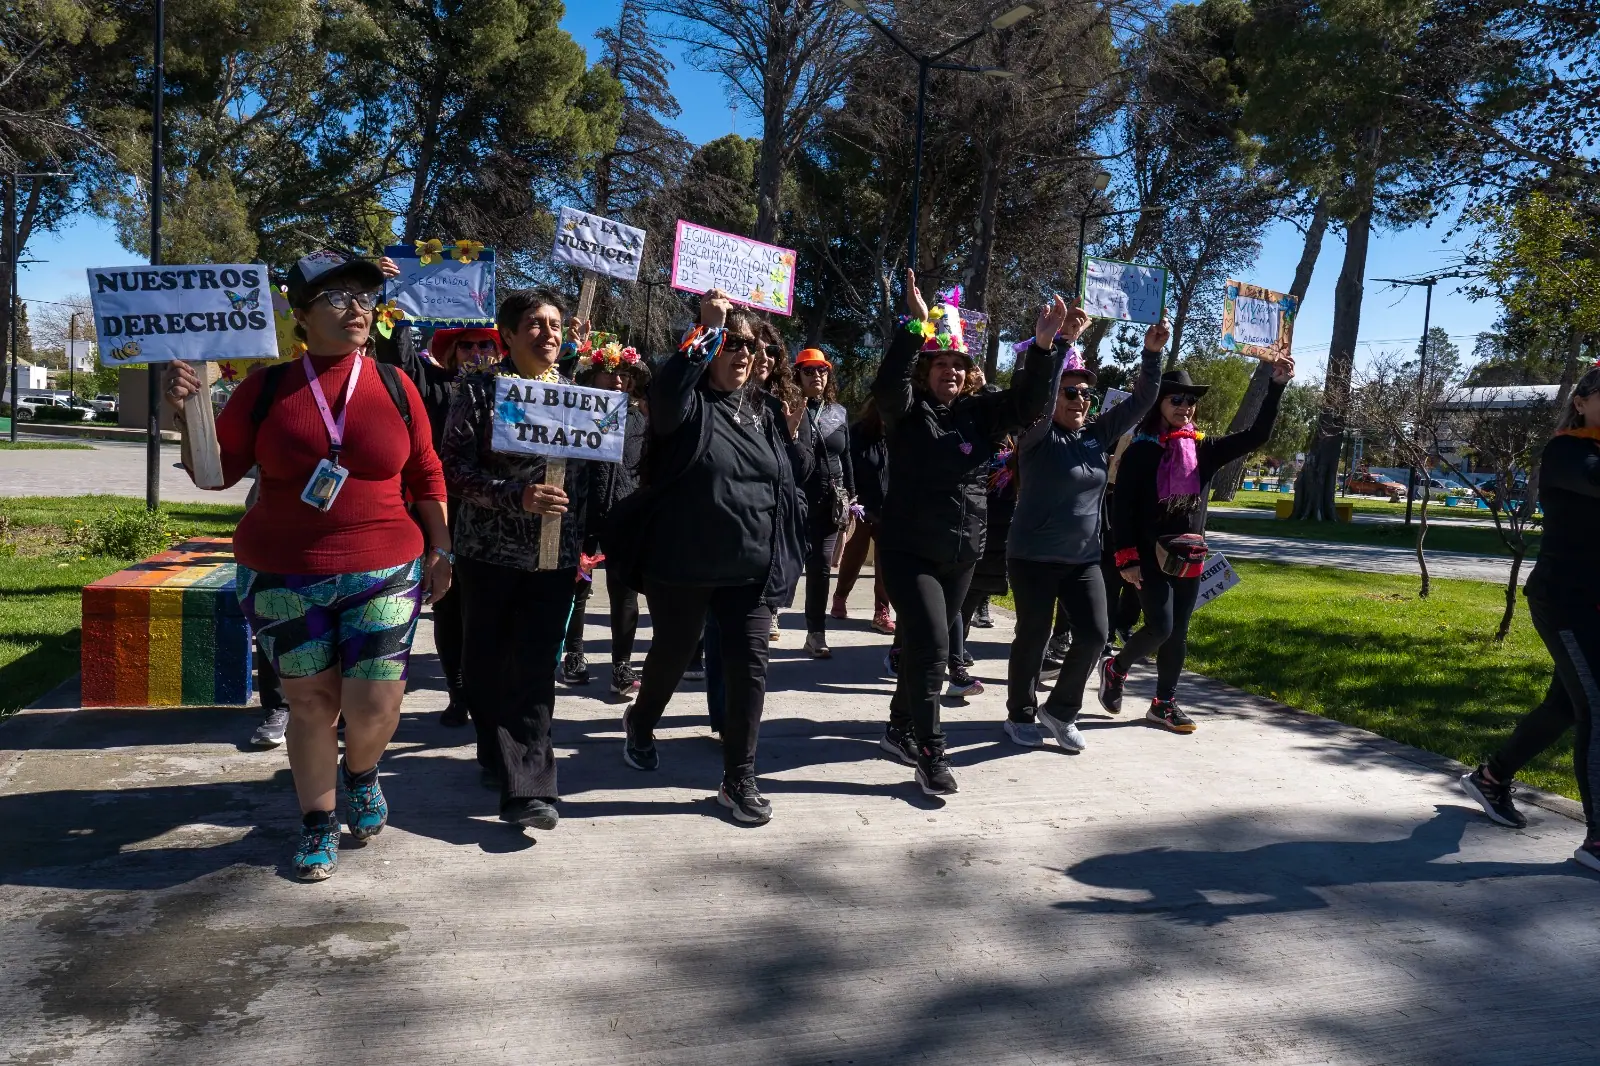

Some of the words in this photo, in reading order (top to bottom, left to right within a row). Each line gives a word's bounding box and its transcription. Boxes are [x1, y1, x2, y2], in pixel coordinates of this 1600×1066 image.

[579, 215, 590, 227] A
[601, 220, 621, 236] LA
[558, 234, 634, 265] JUSTICIA
[679, 240, 770, 275] DISCRIMINACION
[684, 227, 739, 252] IGUALDAD
[741, 240, 756, 257] Y
[762, 248, 782, 264] NO
[95, 269, 261, 294] NUESTROS
[679, 254, 698, 269] POR
[709, 261, 764, 287] RAZONES
[680, 269, 699, 284] DE
[714, 277, 750, 297] EDAD
[101, 310, 267, 337] DERECHOS
[504, 383, 537, 404] AL
[542, 388, 610, 414] BUEN
[514, 422, 602, 449] TRATO
